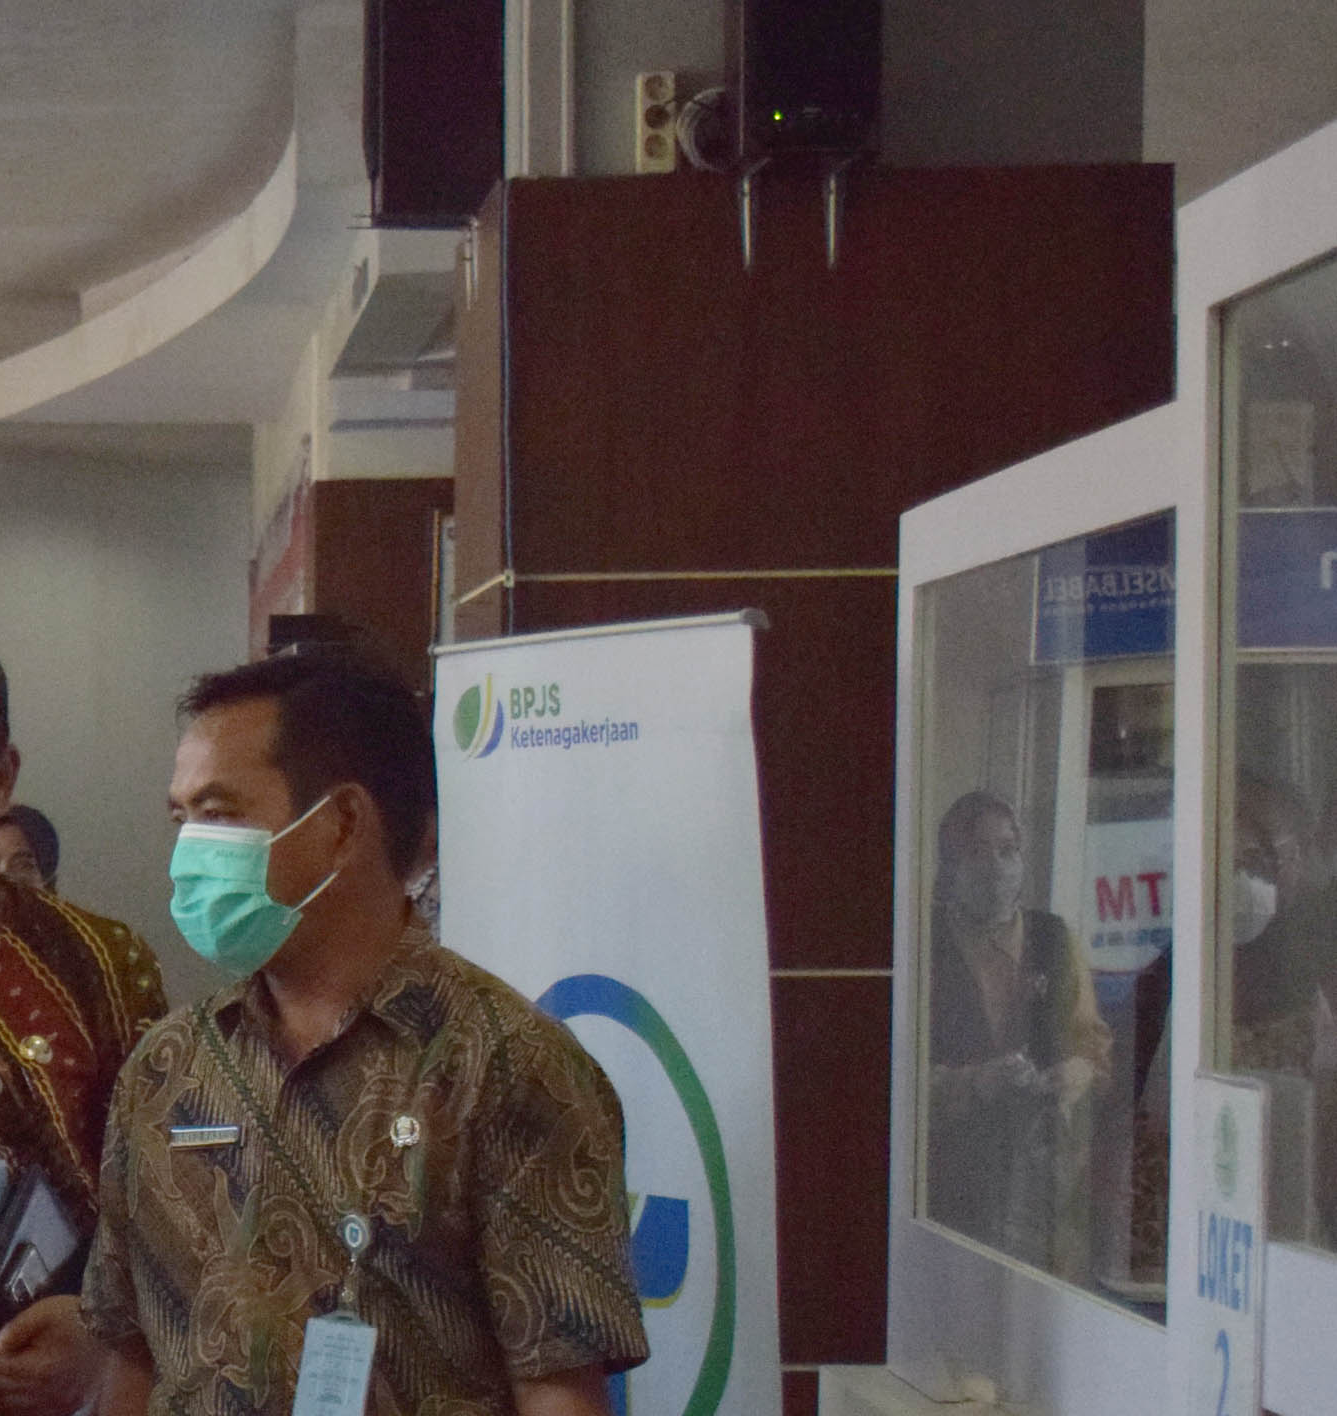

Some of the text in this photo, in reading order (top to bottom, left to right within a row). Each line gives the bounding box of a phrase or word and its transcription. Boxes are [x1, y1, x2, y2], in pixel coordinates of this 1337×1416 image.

[510, 682, 561, 719] BPJS
[510, 716, 639, 750] Ketenagakerjaan
[1197, 1209, 1253, 1315] LOKET
